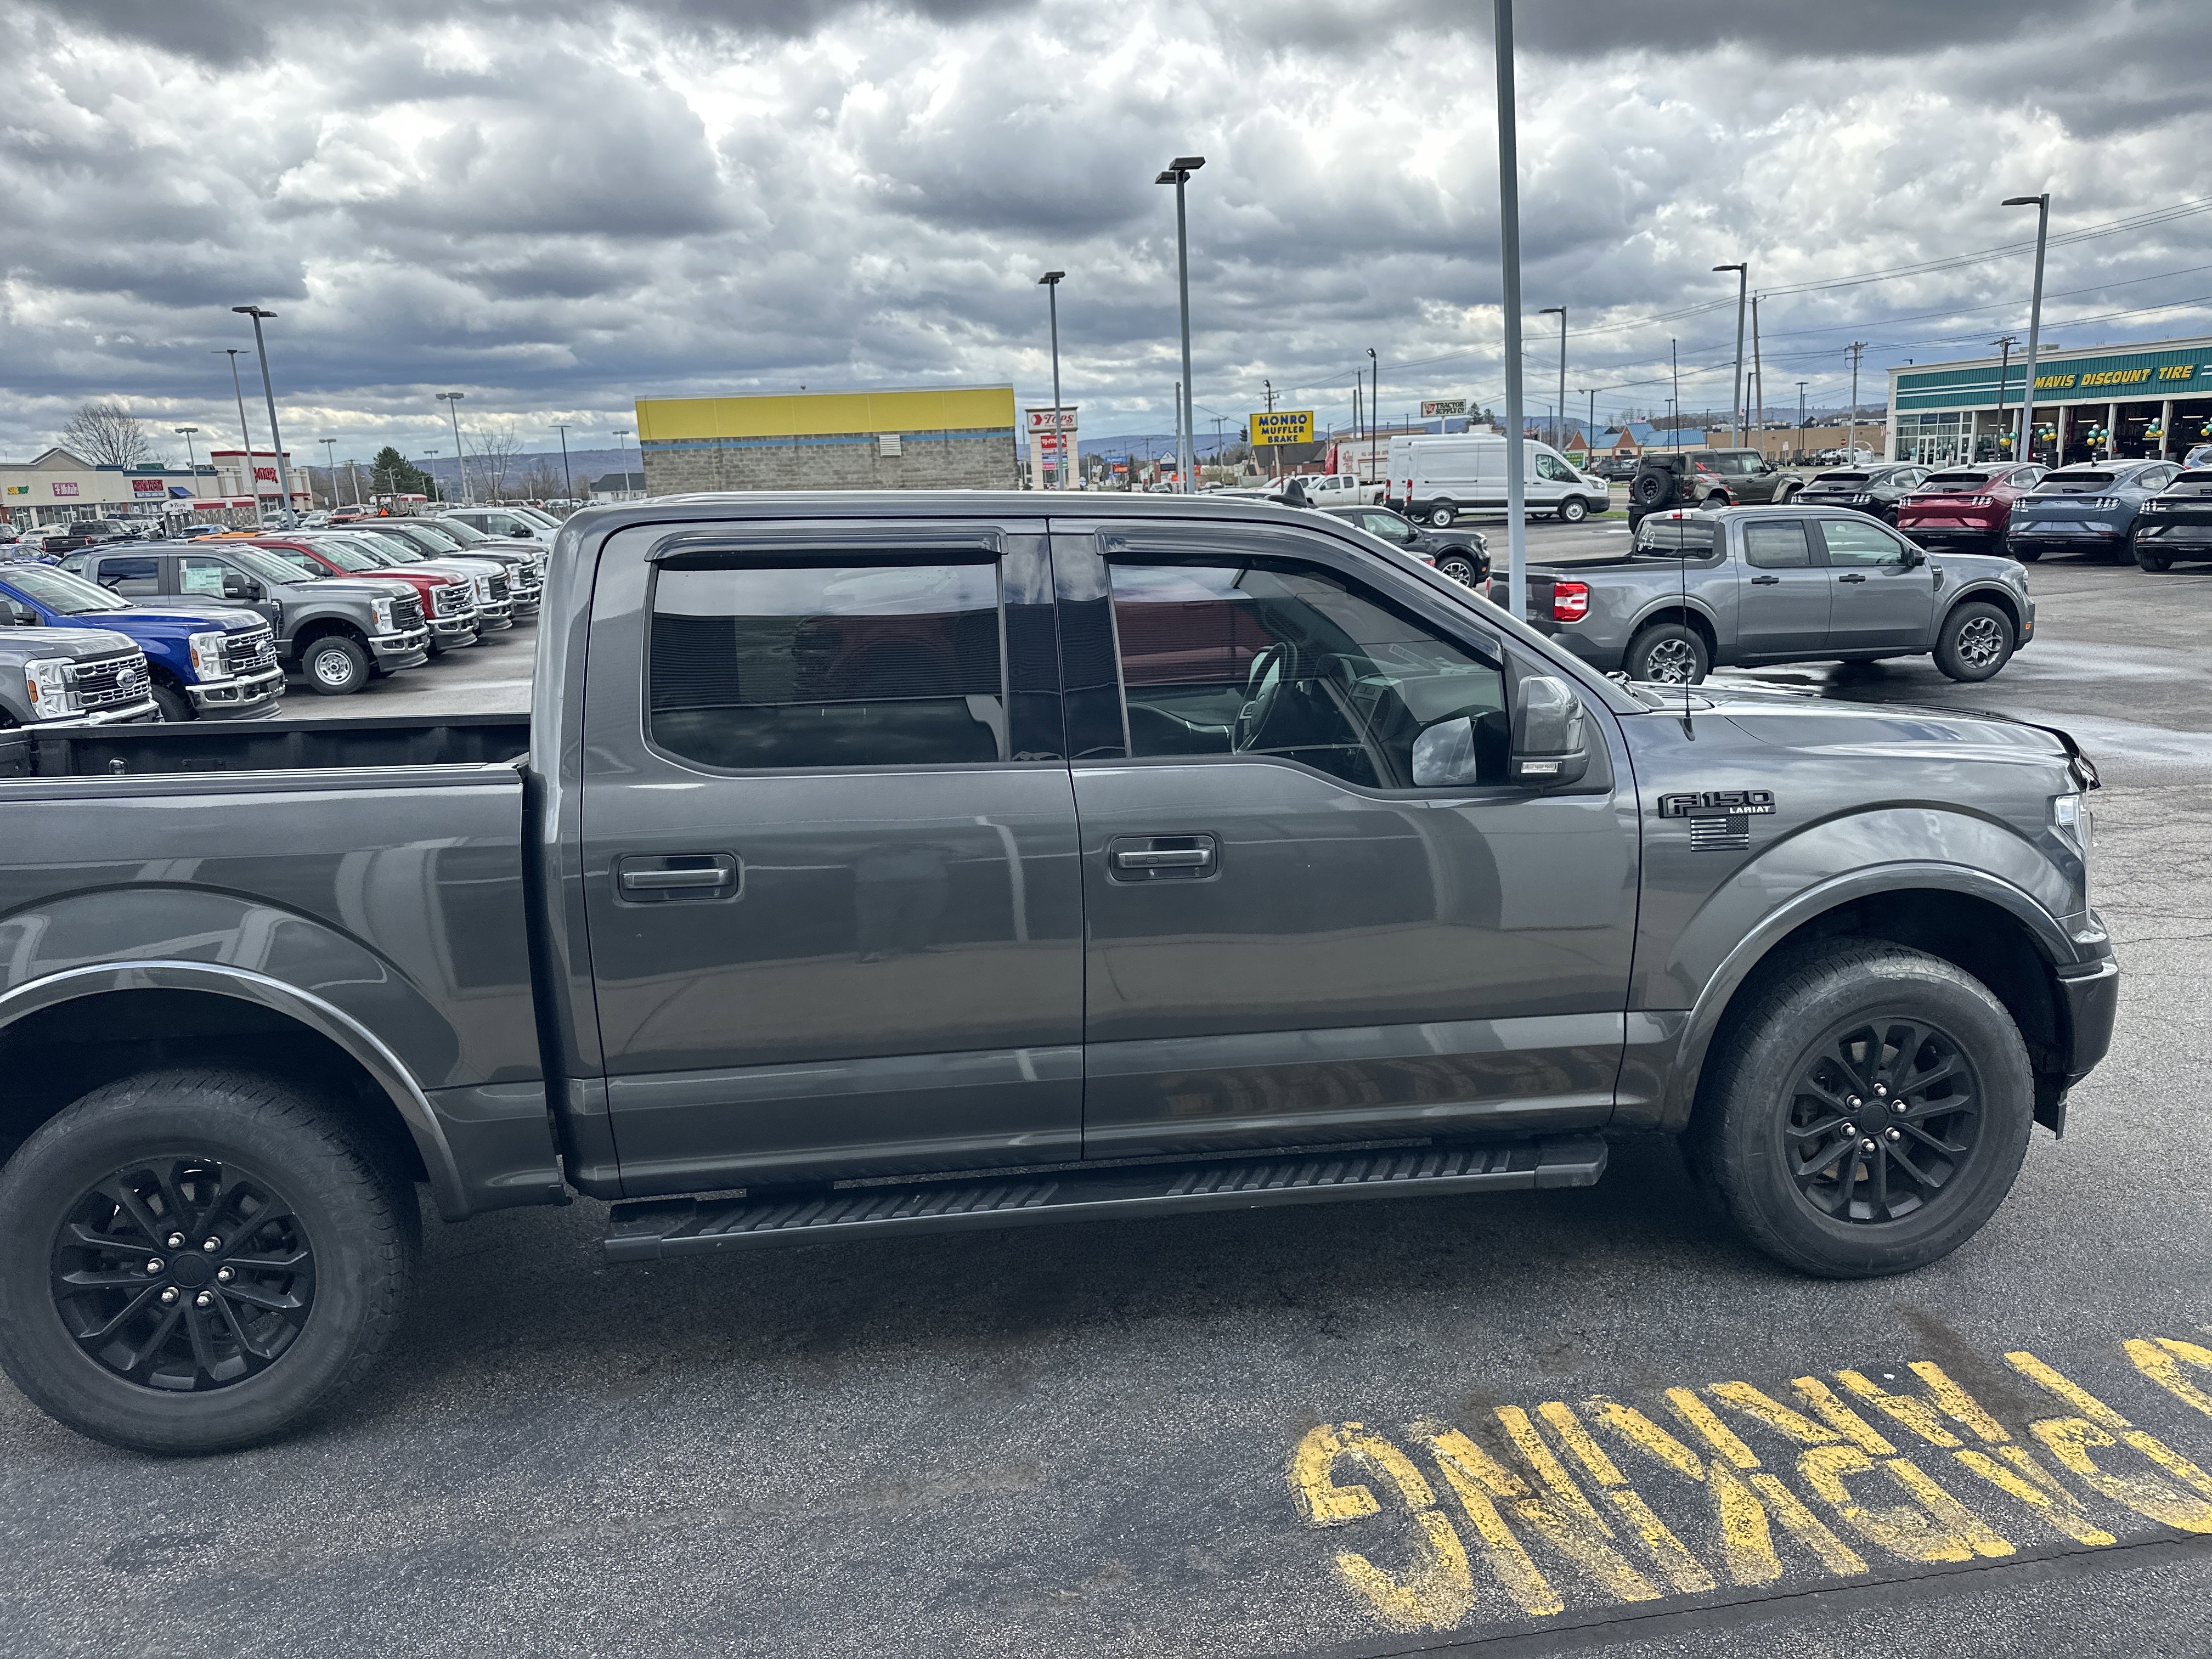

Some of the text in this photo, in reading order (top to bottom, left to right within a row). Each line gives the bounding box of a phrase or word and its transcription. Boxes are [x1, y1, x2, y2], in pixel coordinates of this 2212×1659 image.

[2034, 365, 2194, 388] MAVIS DISCOUNT TIRE
[1259, 414, 1307, 426] MONRO
[1262, 426, 1304, 435] MUFFLER
[1641, 529, 1655, 550] 43
[1286, 1350, 2212, 1633] PARKING
